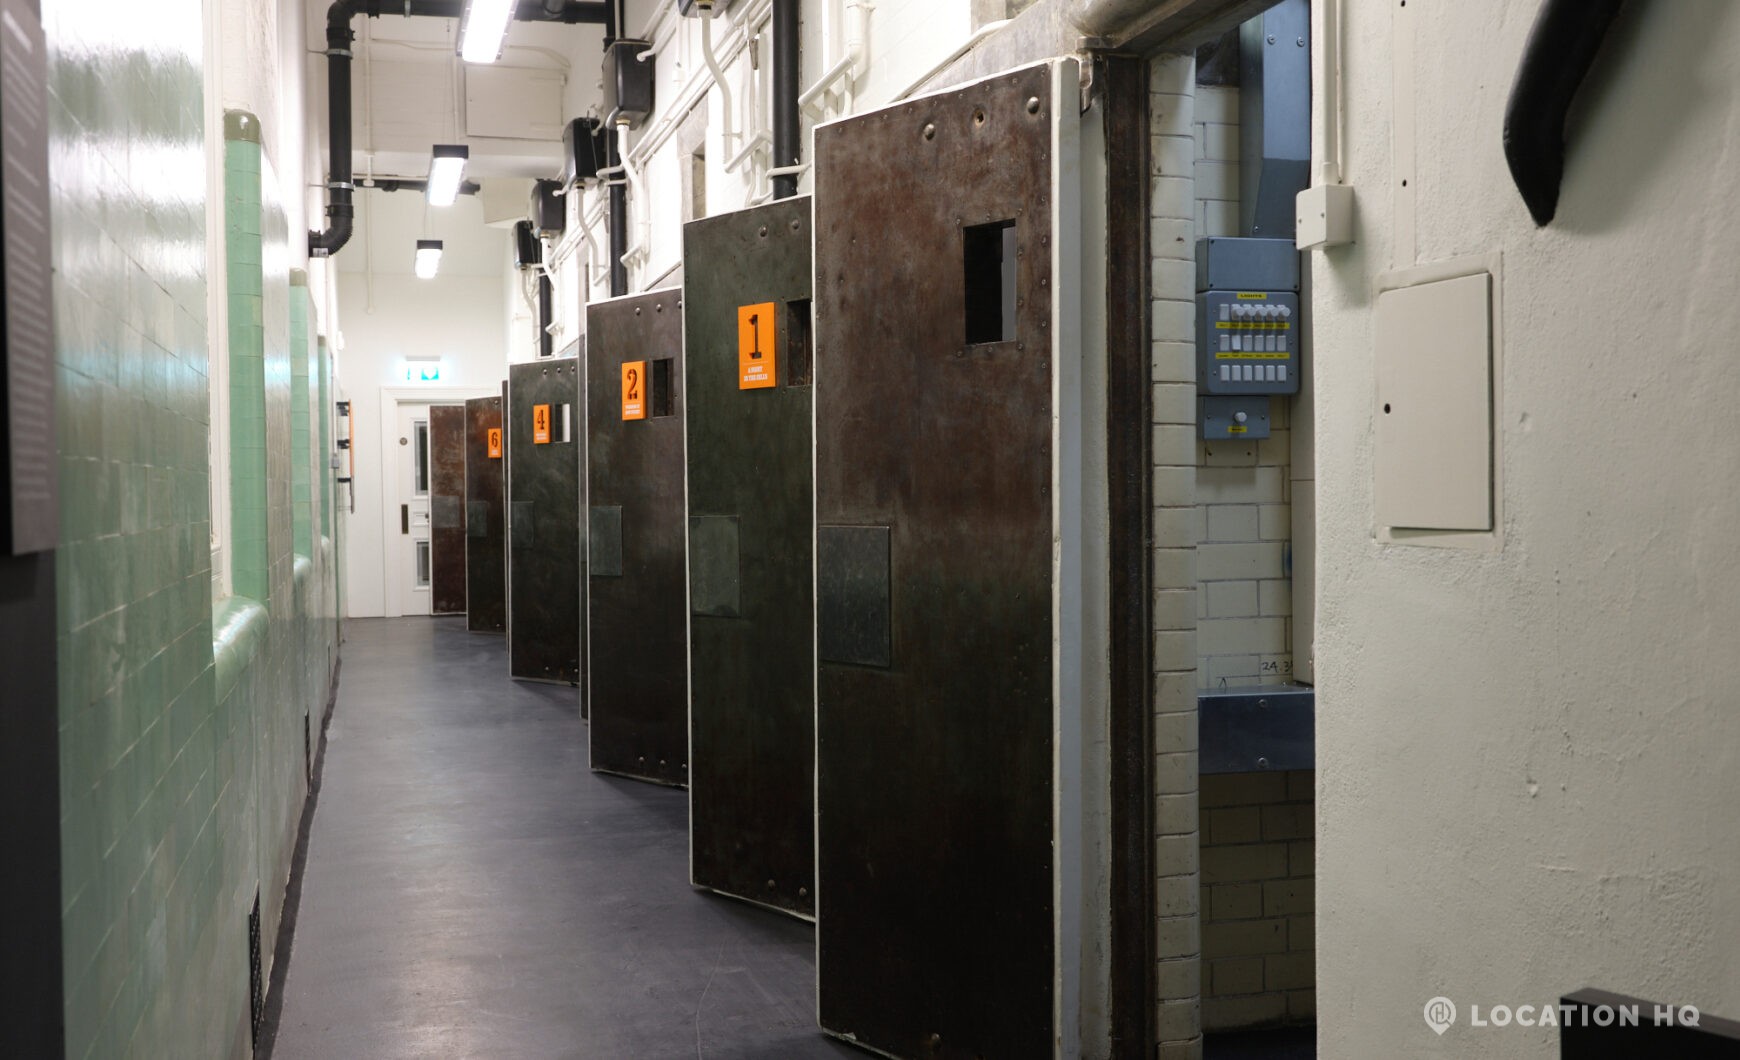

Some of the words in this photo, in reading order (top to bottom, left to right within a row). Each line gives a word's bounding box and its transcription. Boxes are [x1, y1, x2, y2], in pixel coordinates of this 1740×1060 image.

[748, 314, 762, 359] 1
[626, 368, 638, 400] 2
[537, 409, 545, 430] 4
[491, 431, 498, 448] 6
